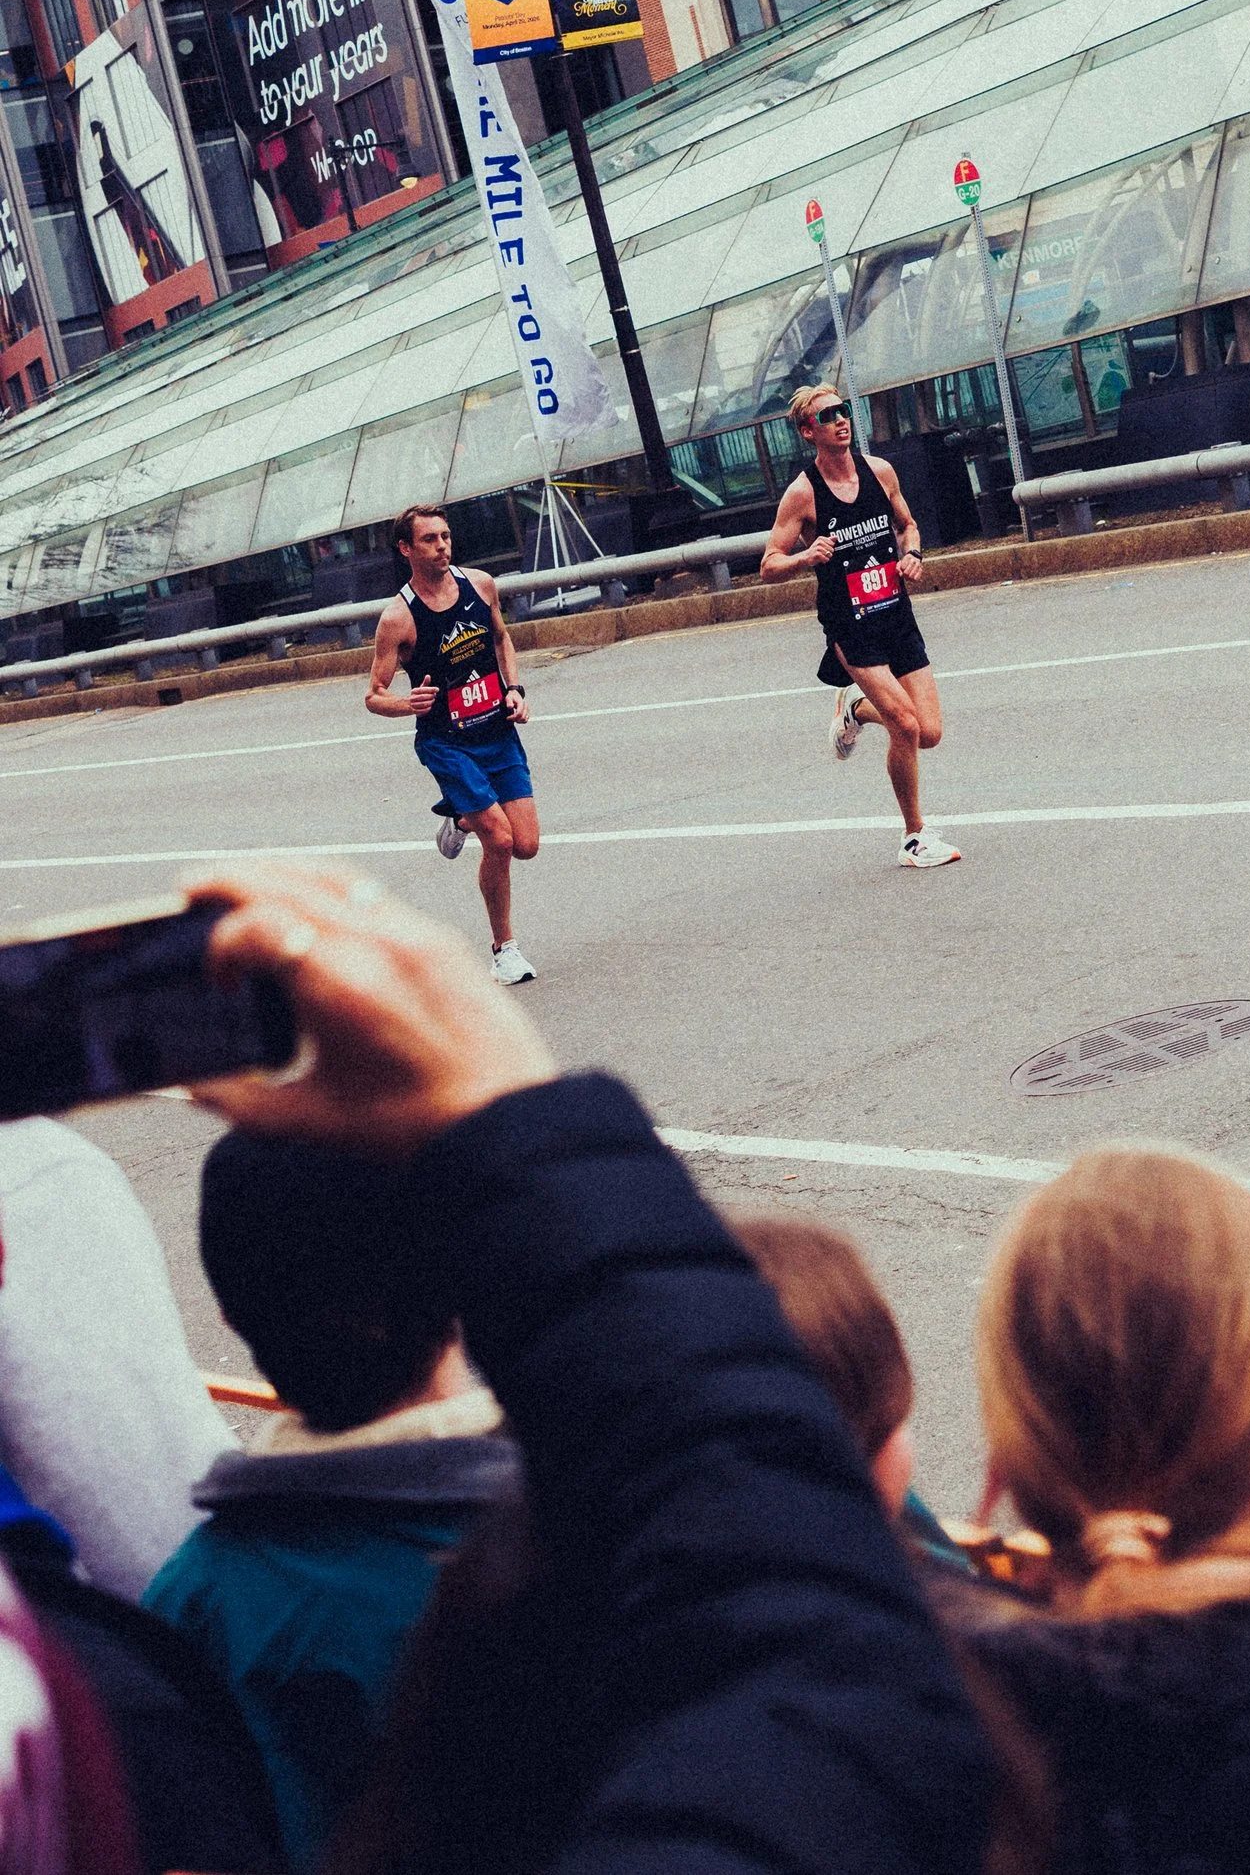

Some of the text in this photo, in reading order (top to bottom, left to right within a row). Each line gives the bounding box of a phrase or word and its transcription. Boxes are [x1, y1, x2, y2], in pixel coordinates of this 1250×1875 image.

[260, 23, 388, 126] to your years
[959, 161, 970, 182] F
[958, 184, 980, 200] G-20
[809, 202, 816, 221] F
[483, 153, 525, 269] MILE
[511, 284, 541, 342] TO
[530, 356, 559, 415] GO
[861, 567, 888, 593] 891
[461, 680, 488, 707] 941
